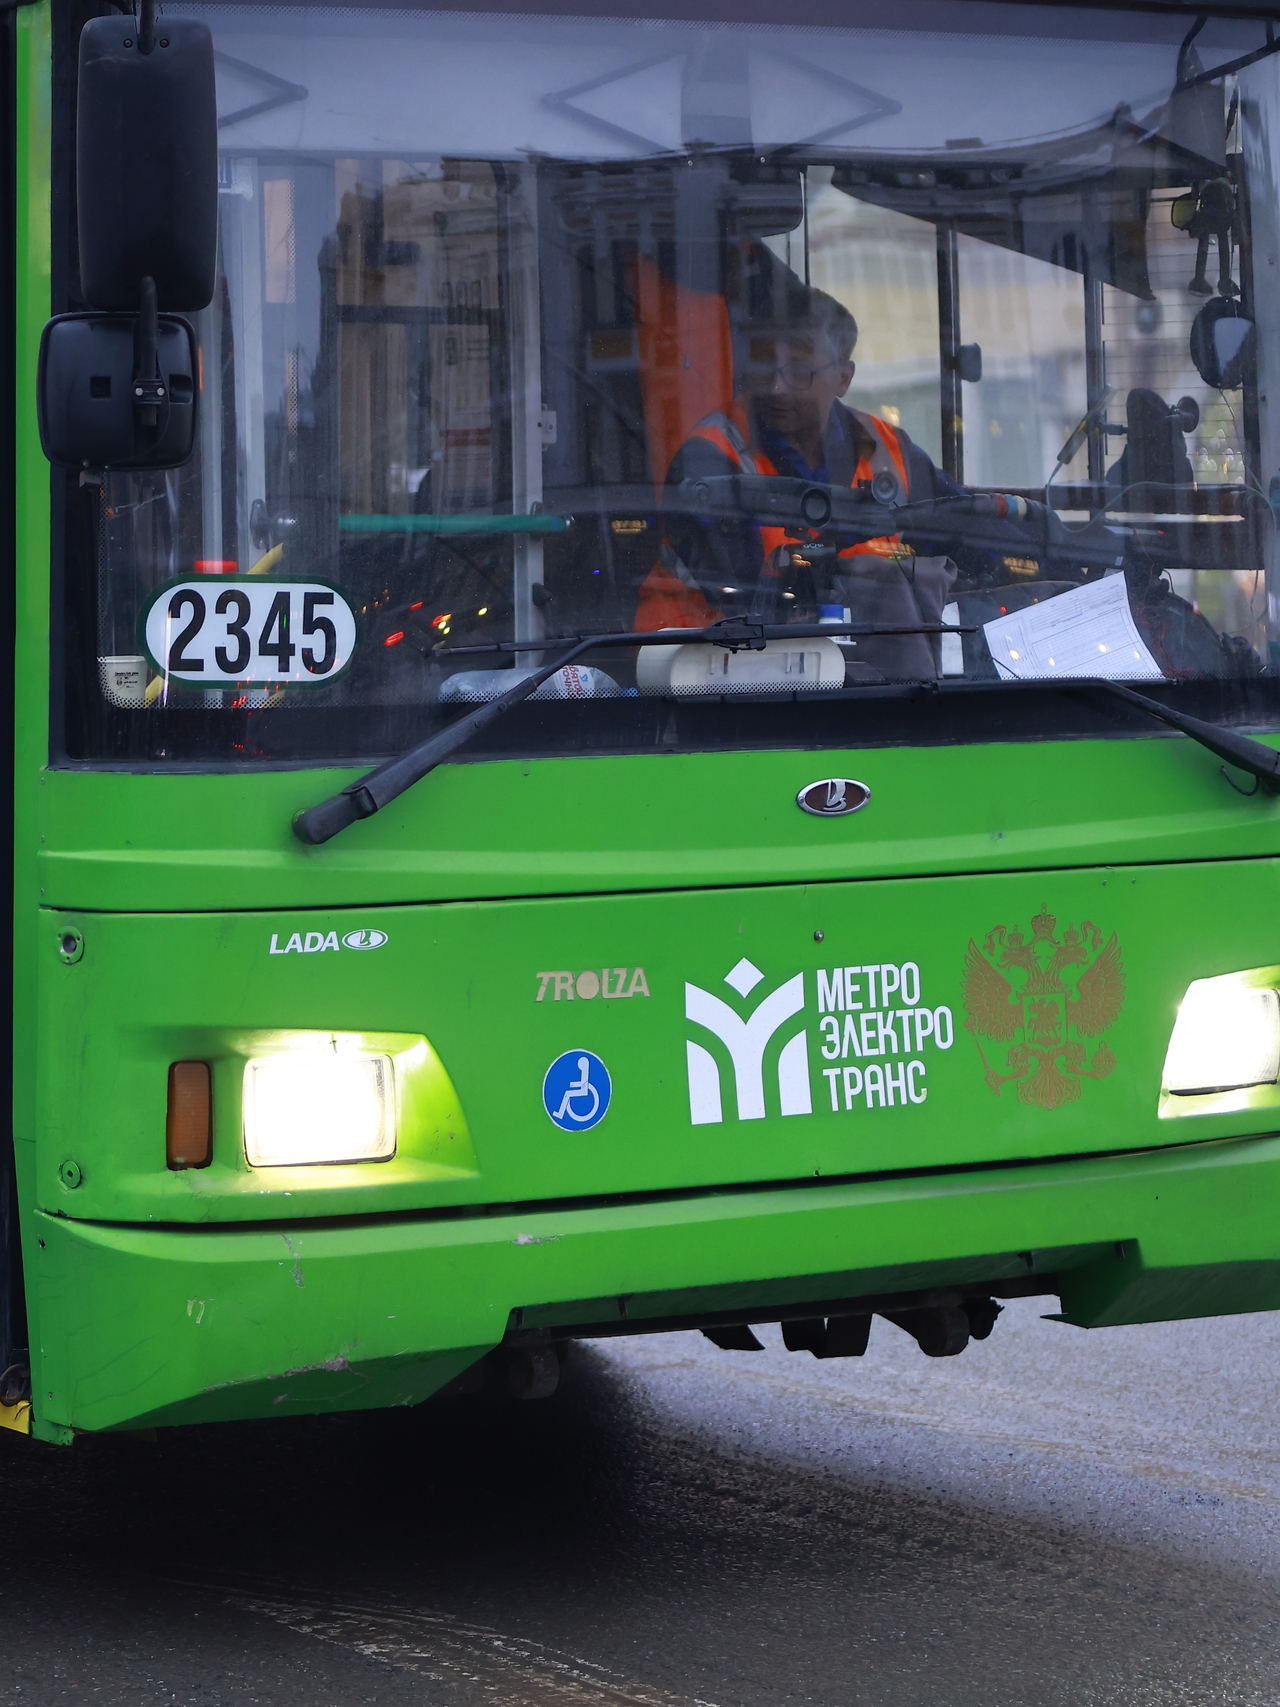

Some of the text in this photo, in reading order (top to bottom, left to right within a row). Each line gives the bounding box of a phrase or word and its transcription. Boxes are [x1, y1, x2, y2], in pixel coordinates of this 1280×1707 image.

[168, 589, 336, 675] 2345
[269, 931, 340, 954] LADA
[535, 967, 651, 1001] TROLZA
[817, 961, 920, 1013] МЕТРО
[820, 1005, 954, 1060] ЭЛЕКТРО
[823, 1060, 928, 1112] ТРАНС
